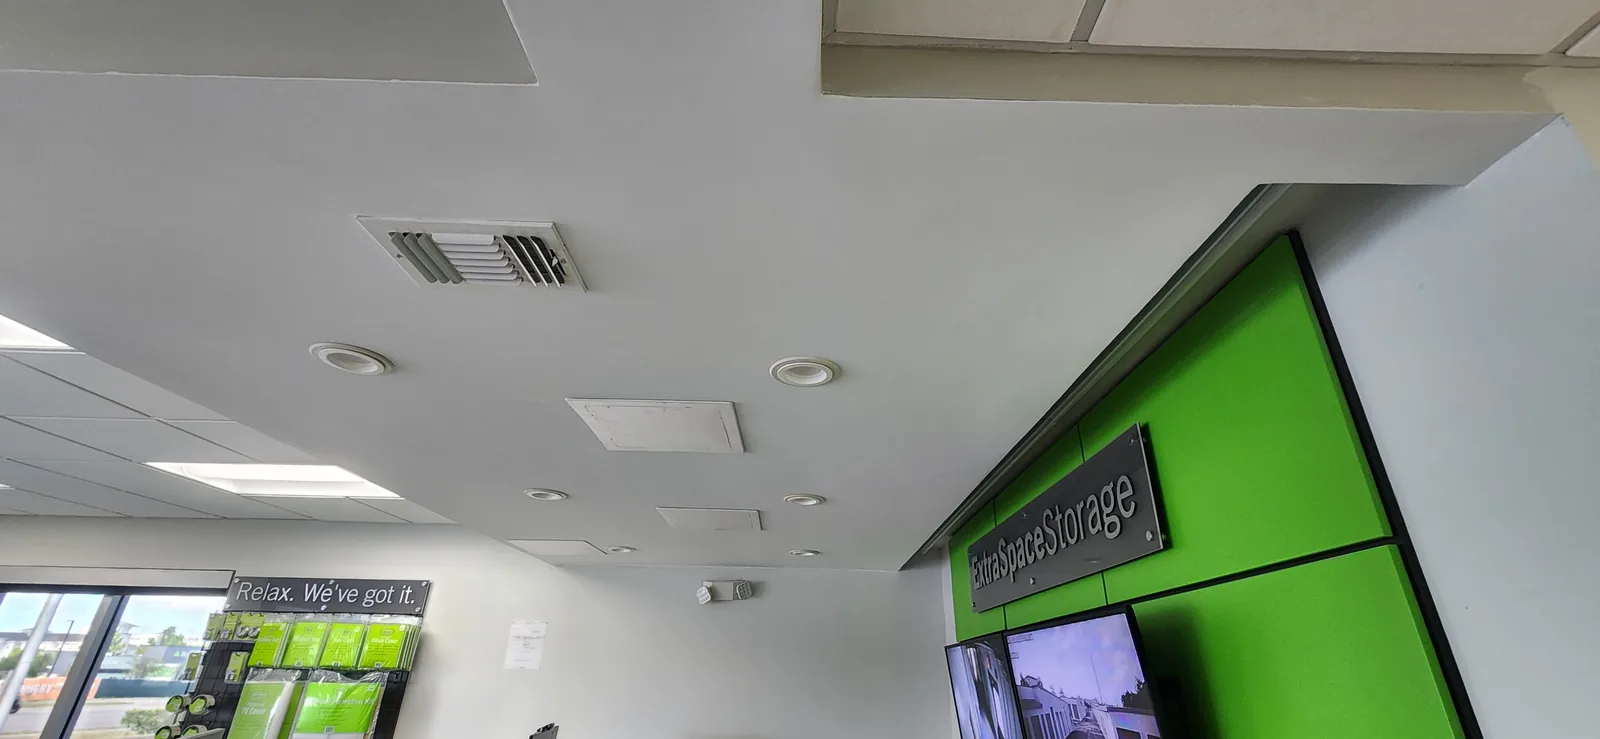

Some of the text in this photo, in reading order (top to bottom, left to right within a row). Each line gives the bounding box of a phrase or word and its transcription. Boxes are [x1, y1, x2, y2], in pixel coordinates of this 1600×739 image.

[972, 475, 1135, 590] ExtraSpaceStorage
[236, 582, 415, 608] Relax. We've got it.
